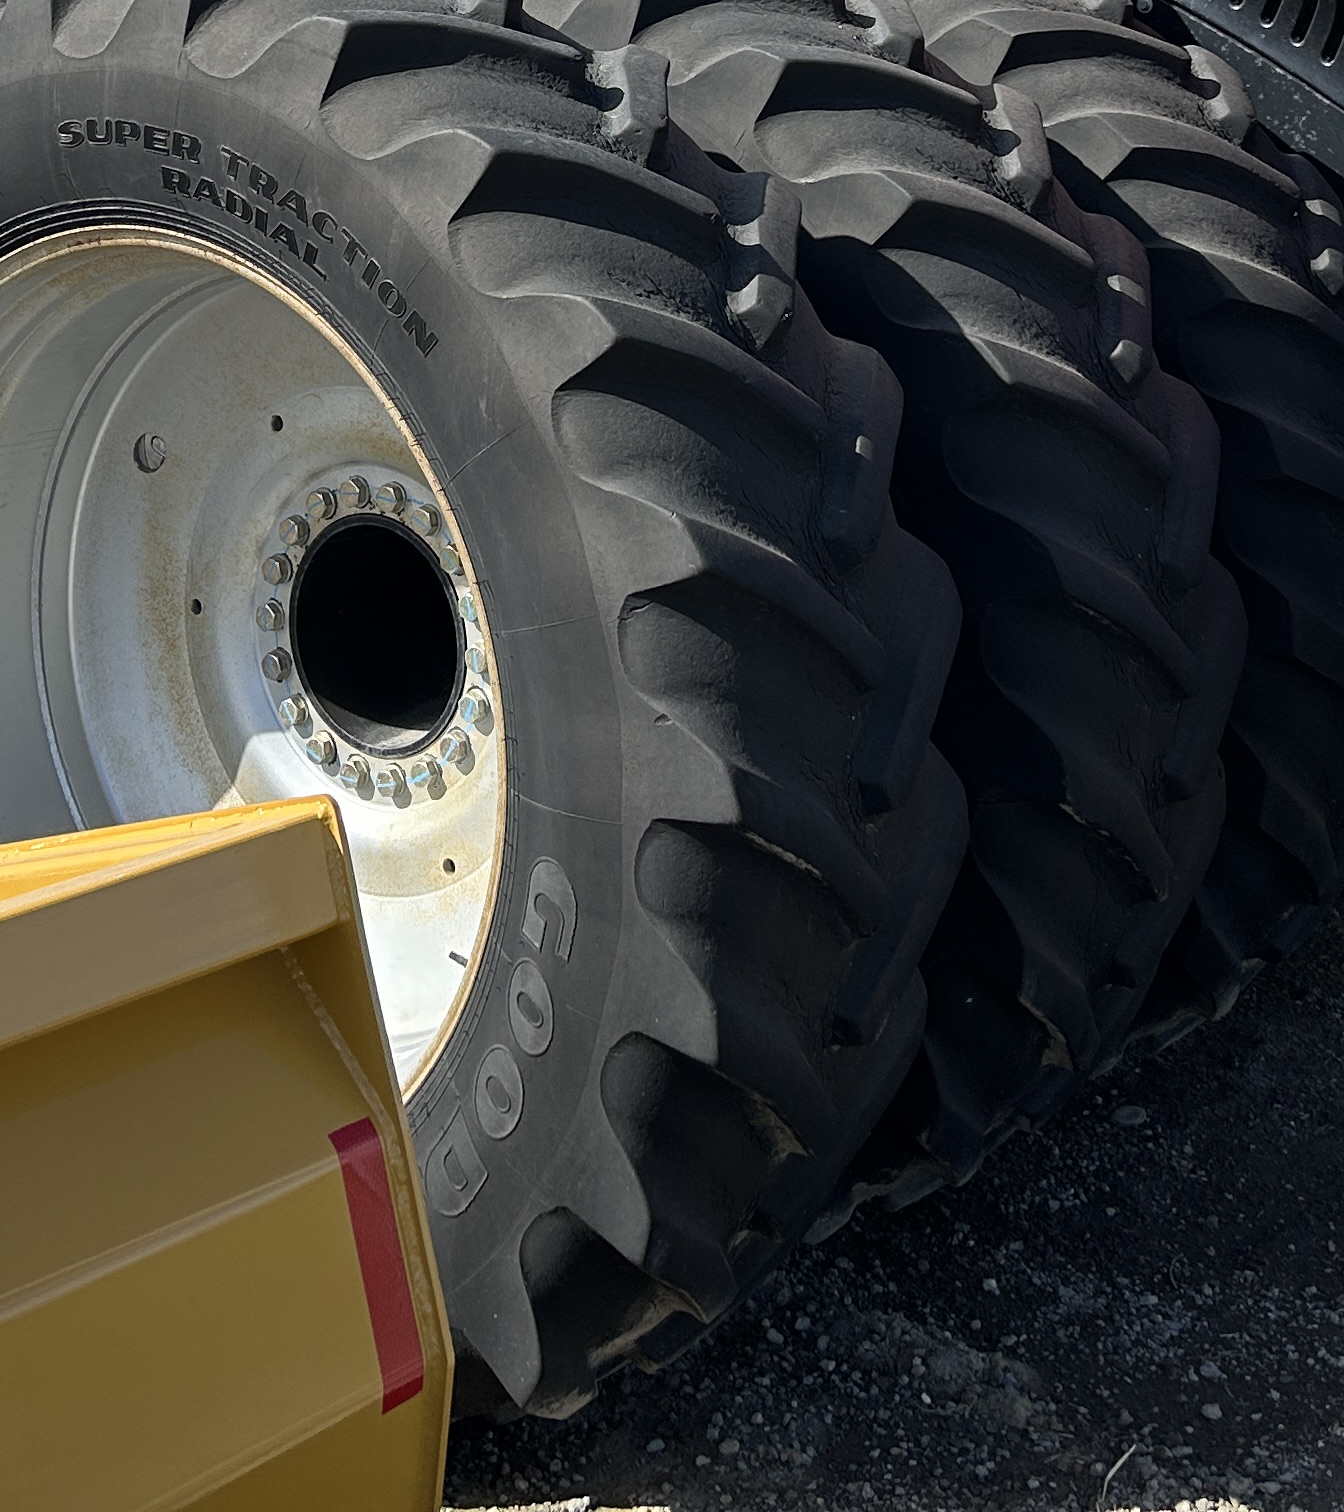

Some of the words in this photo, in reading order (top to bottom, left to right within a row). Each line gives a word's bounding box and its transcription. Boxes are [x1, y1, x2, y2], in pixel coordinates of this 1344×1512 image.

[58, 117, 202, 165] SUPER
[219, 144, 439, 358] TRACTION
[160, 164, 328, 282] RADIAL
